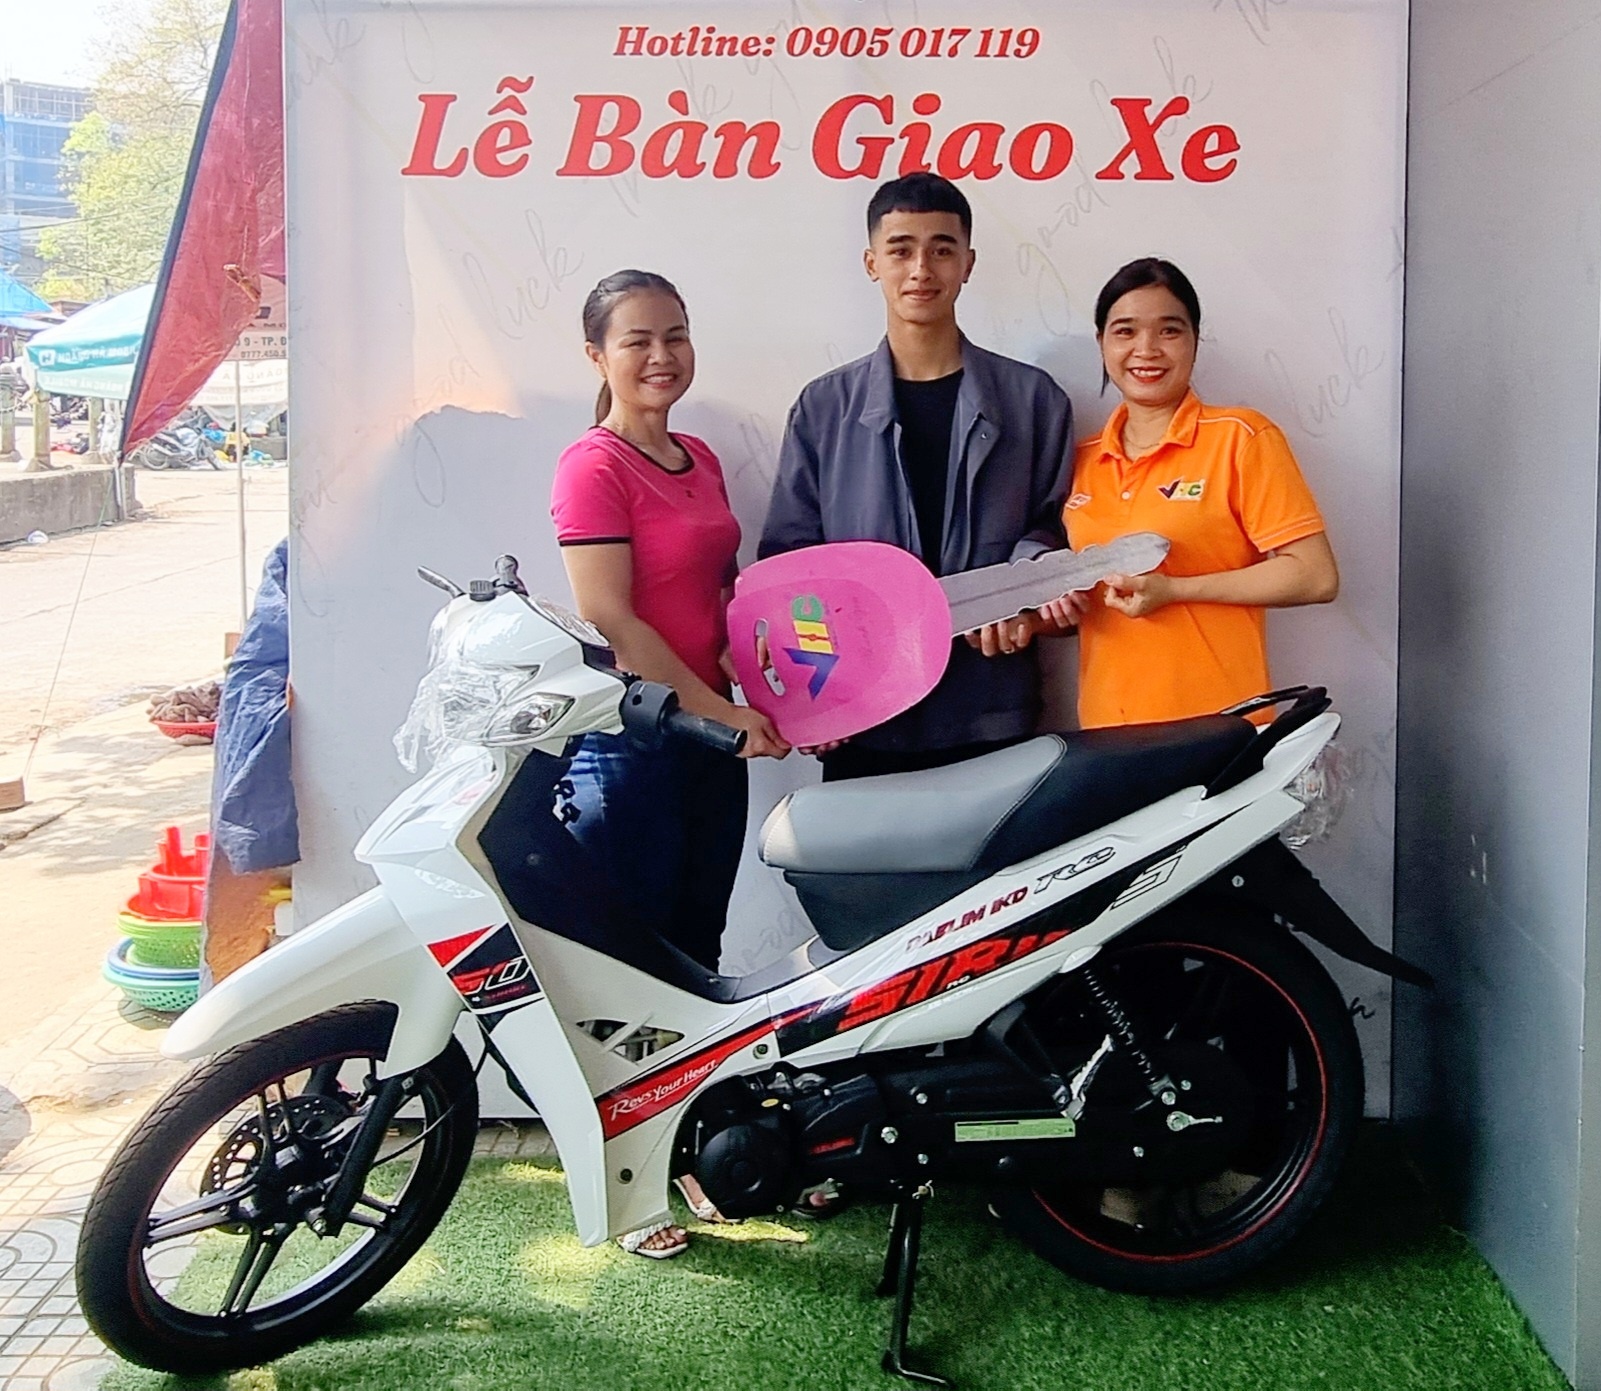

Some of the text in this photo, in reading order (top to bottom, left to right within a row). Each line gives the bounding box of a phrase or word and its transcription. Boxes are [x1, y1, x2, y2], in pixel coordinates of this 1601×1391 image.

[612, 26, 1042, 58] Hotline: 0905 017 119
[401, 76, 534, 178] Lễ
[555, 90, 782, 180] Bàn
[811, 92, 1075, 182] Giao
[1096, 95, 1241, 183] Xe
[607, 1090, 653, 1121] Revs
[652, 1076, 684, 1102] Your
